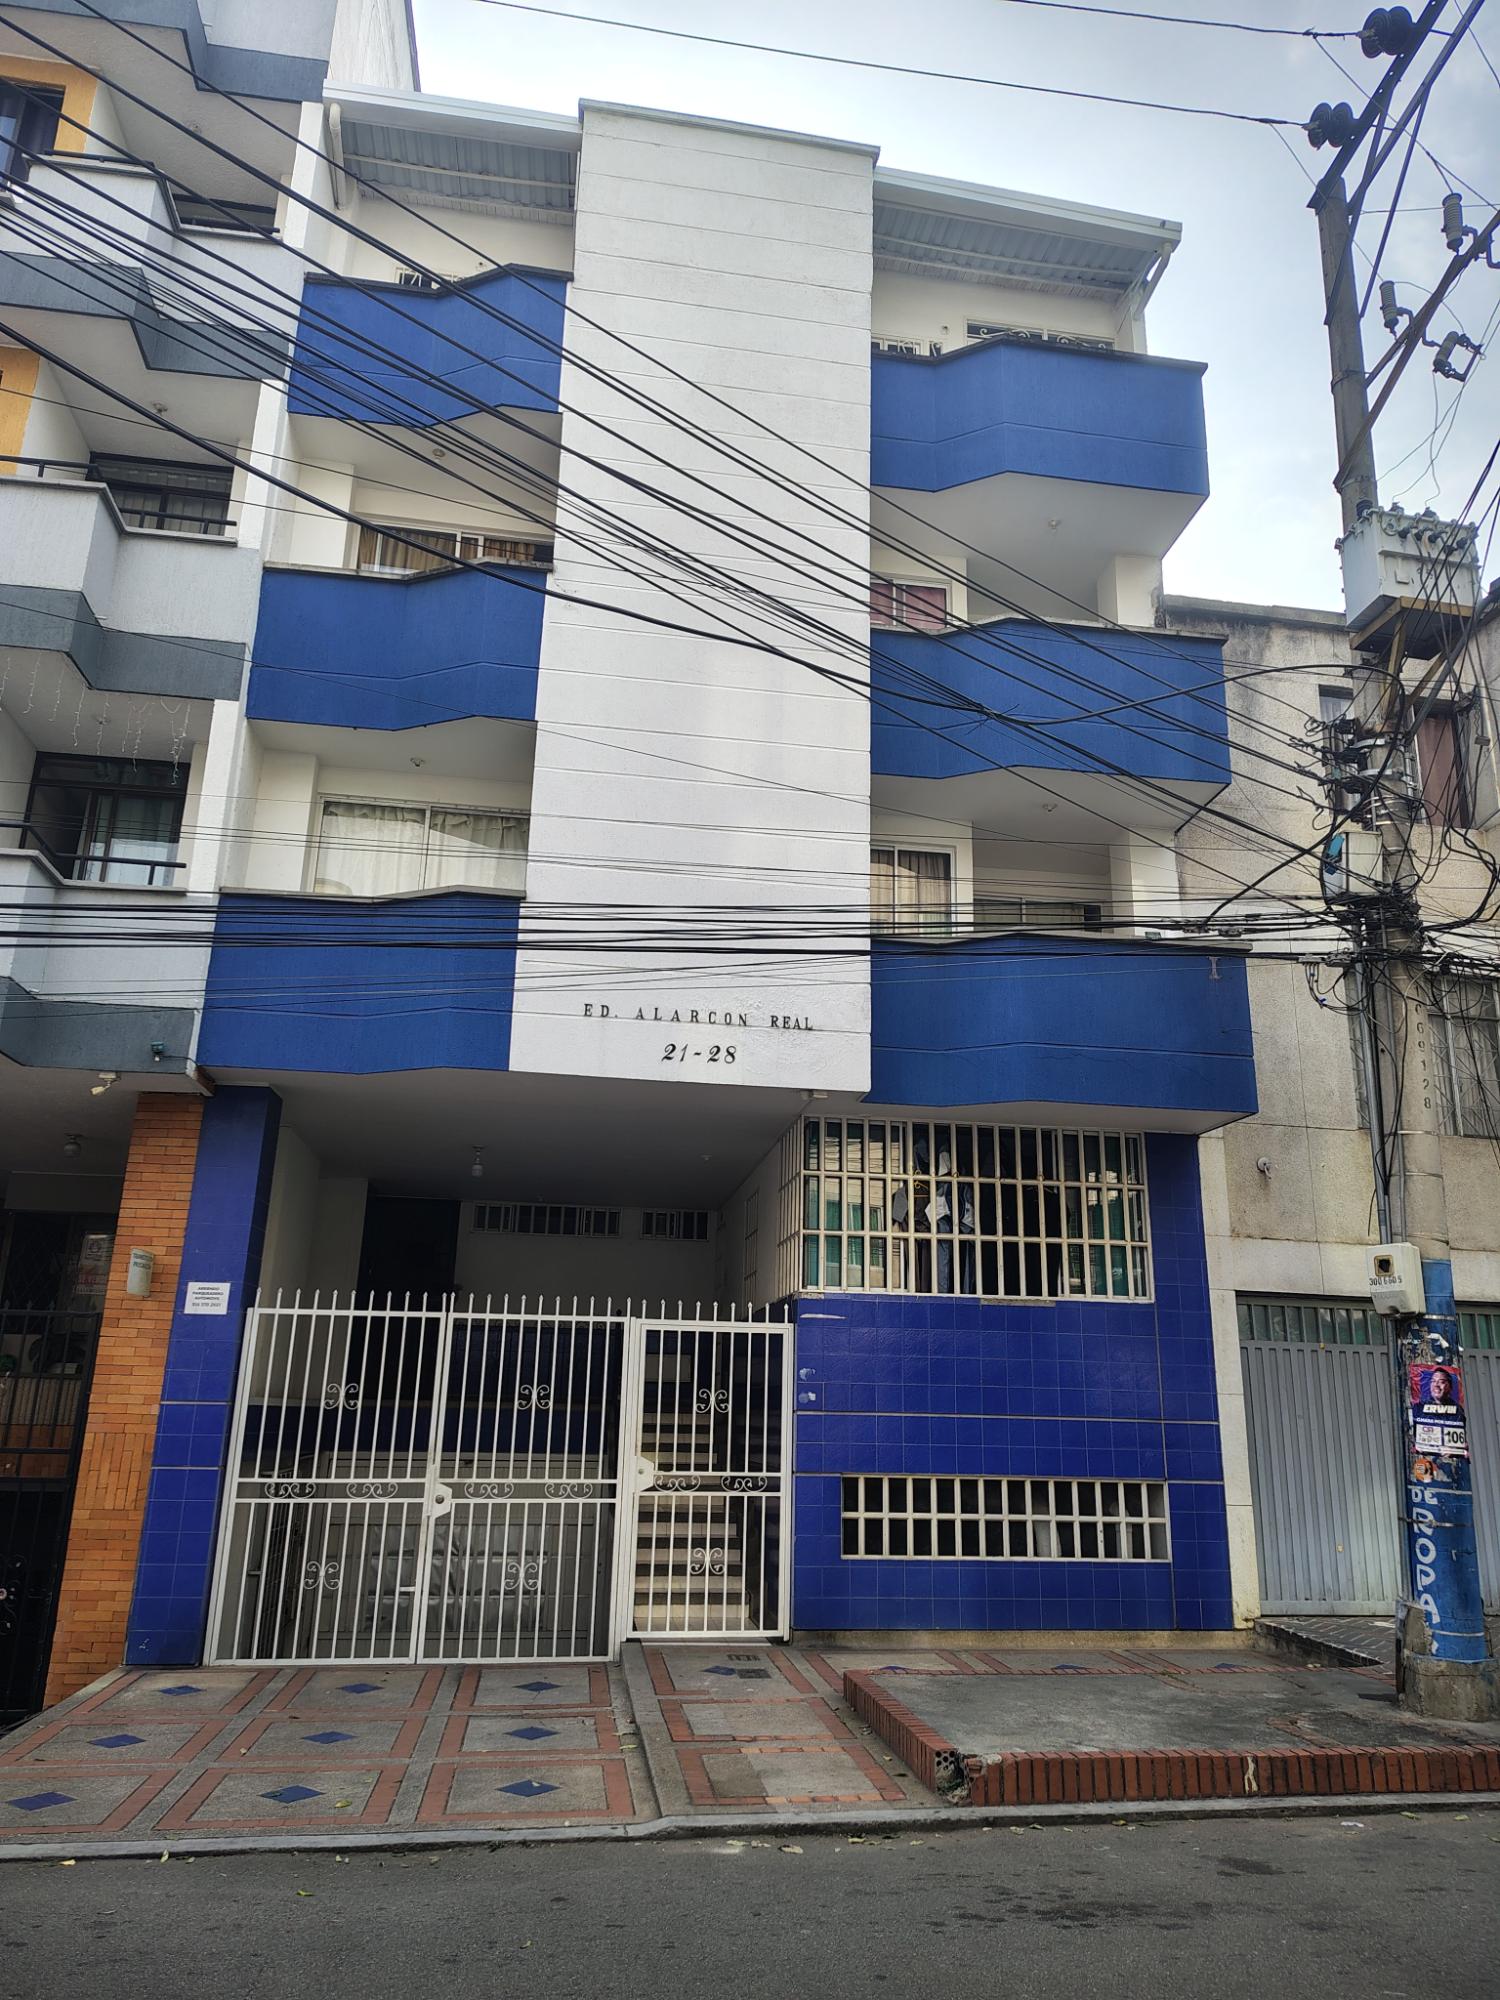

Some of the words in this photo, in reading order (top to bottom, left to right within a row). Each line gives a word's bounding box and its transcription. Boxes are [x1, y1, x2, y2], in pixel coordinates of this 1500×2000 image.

[583, 1003, 618, 1018] ED.
[635, 1007, 748, 1027] ALARCON
[769, 1015, 814, 1030] REAL
[661, 1043, 737, 1064] 21-28
[1445, 1430, 1465, 1444] 106
